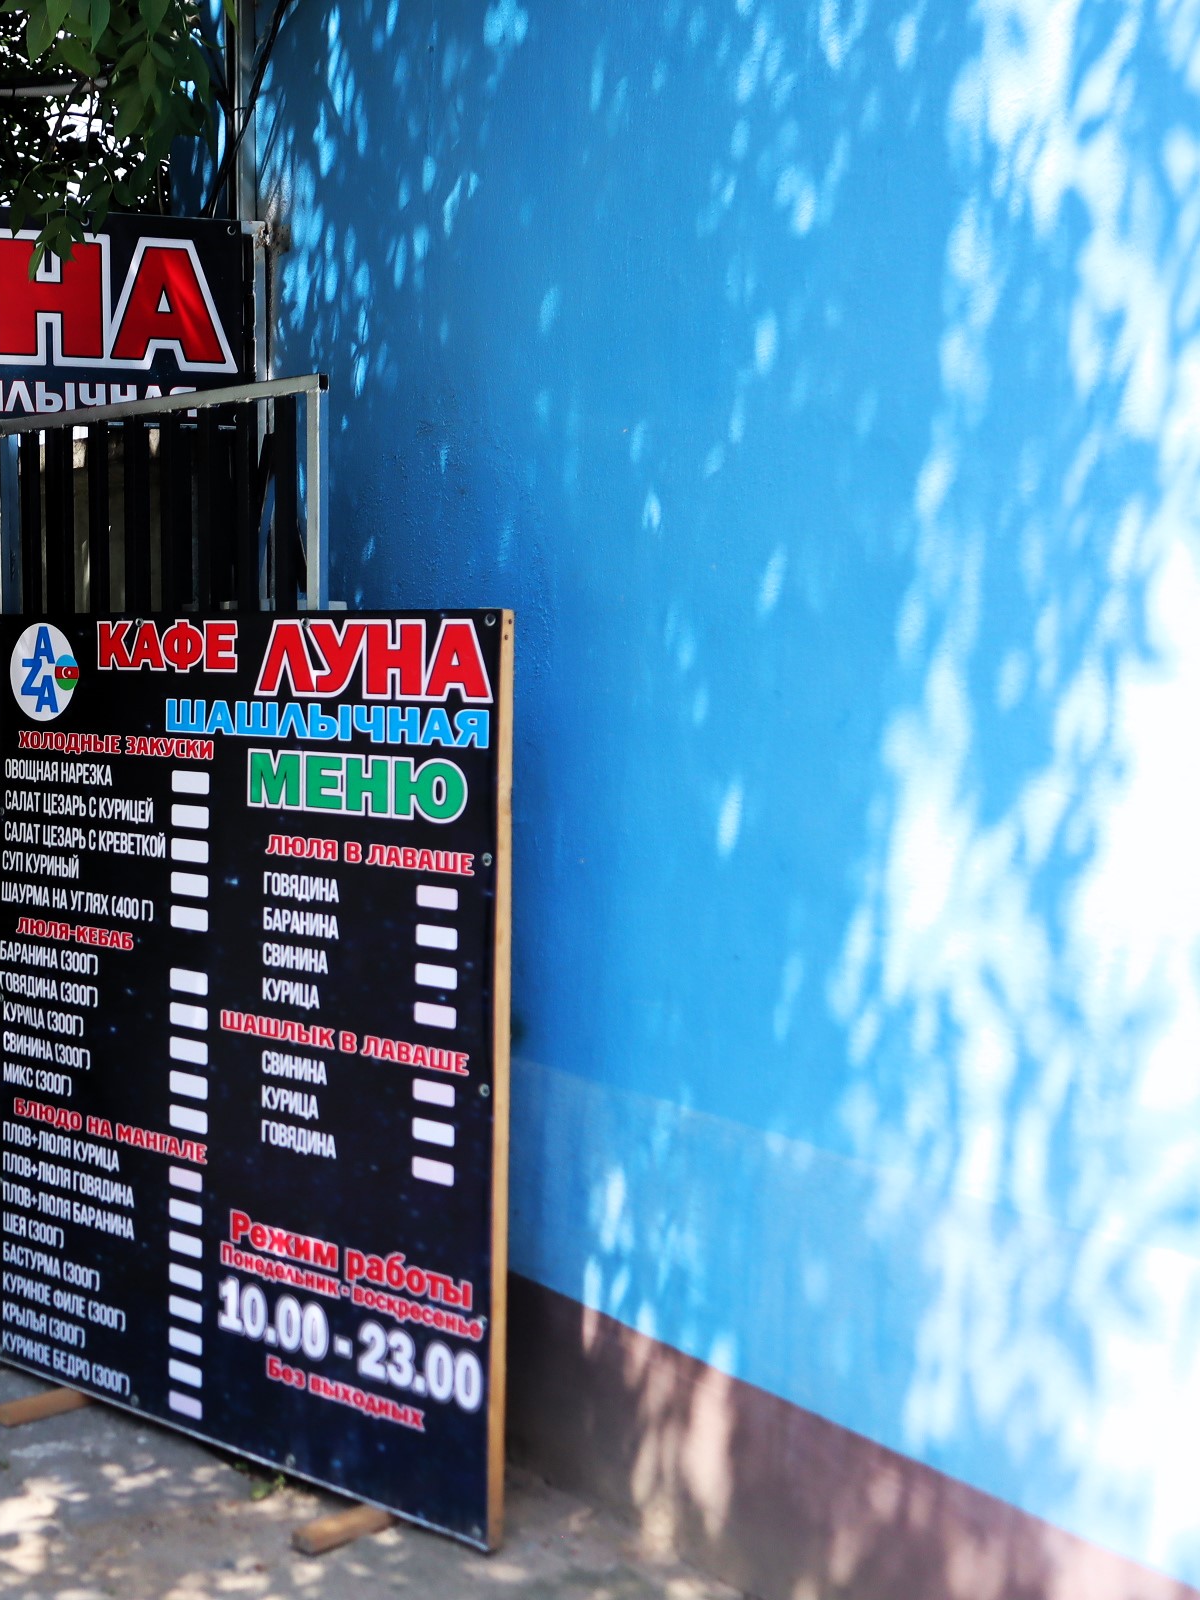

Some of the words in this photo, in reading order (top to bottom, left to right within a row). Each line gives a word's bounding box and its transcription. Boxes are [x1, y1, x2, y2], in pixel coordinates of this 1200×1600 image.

[97, 619, 238, 673] КАФЕ
[253, 617, 494, 704] ЛУНА
[165, 698, 490, 748] ШАШЛЫЧНАЯ
[18, 730, 121, 754] ХОЛОДНЫЕ
[125, 736, 214, 760] ЗАКУСКИ
[5, 759, 58, 782] ОВОЩНАЯ
[61, 762, 112, 786] НАРЕЗКА
[246, 747, 468, 823] МЕНЮ
[5, 790, 41, 812] САЛАТ
[43, 793, 86, 817] ЦЕЗАРЬ
[88, 797, 97, 818] С
[99, 797, 154, 824] КУРИЦЕЙ
[4, 821, 40, 844] САЛАТ
[43, 824, 86, 850] ЦЕЗАРЬ
[88, 829, 96, 851] С
[99, 830, 166, 859] КРЕВЕТКОЙ
[266, 834, 338, 861] ЛЮЛЯ
[344, 841, 362, 864] В
[365, 844, 475, 876] ЛАВАШЕ
[2, 850, 24, 872] СУП
[25, 853, 80, 879] КУРИНЫЙ
[1, 881, 50, 908] ШАУРМА
[52, 888, 68, 910] НА
[70, 890, 109, 916] УГЛЯХ
[263, 871, 339, 904] ГОВЯДИНА
[16, 916, 134, 951] ЛЮЛЯ-КЕБАБ
[263, 906, 339, 940] БАРАНИНА
[0, 940, 58, 970] БАРАНИНА
[61, 950, 98, 976] (300Г)
[262, 942, 329, 975] СВИНИНА
[0, 971, 58, 1001] ГОВЯДИНА
[61, 981, 98, 1008] (300Г)
[262, 977, 320, 1010] КУРИЦА
[3, 1001, 45, 1030] КУРИЦА
[47, 1010, 84, 1037] (300Г)
[3, 1031, 53, 1061] СВИНИНА
[55, 1043, 91, 1070] (300Г)
[220, 1009, 335, 1050] ШАШЛЫК
[339, 1030, 357, 1054] В
[360, 1035, 469, 1077] ЛАВАШЕ
[3, 1062, 34, 1088] МИКС
[36, 1070, 72, 1097] (300Г)
[261, 1050, 327, 1086] СВИНИНА
[261, 1084, 319, 1120] КУРИЦА
[3, 1121, 71, 1158] ПЛОВ+ЛЮЛЯ
[73, 1140, 120, 1172] КУРИЦА
[13, 1097, 82, 1131] БЛЮДО
[86, 1115, 113, 1140] НА
[116, 1123, 208, 1165] МАНГАЛЕ
[261, 1119, 337, 1160] ГОВЯДИНА
[3, 1151, 71, 1189] ПЛОВ+ЛЮЛЯ
[73, 1171, 135, 1208] ГОВЯДИНА
[2, 1181, 71, 1221] ПЛОВ+ЛЮЛЯ
[73, 1201, 135, 1241] БАРАНИНА
[3, 1211, 27, 1237] ШЕЯ
[28, 1219, 64, 1249] (300Г)
[3, 1241, 61, 1279] БАСТУРМА
[62, 1260, 100, 1292] (300Г)
[229, 1207, 338, 1272] Режим
[344, 1247, 473, 1311] работы
[2, 1271, 51, 1306] КУРИНОЕ
[53, 1289, 86, 1319] ФИЛЕ
[88, 1299, 126, 1332] (300Г)
[220, 1240, 341, 1299] Понедельник
[352, 1284, 483, 1342] воскресенье
[2, 1300, 47, 1333] КРЫЛЬЯ
[49, 1317, 86, 1349] (300Г)
[218, 1275, 330, 1362] 10.00
[357, 1319, 484, 1412] 23.00
[2, 1330, 51, 1366] КУРИНОЕ
[53, 1349, 90, 1381] БЕДРО
[92, 1362, 130, 1396] (300Г)
[266, 1353, 306, 1388] Без
[308, 1373, 425, 1432] выходных
